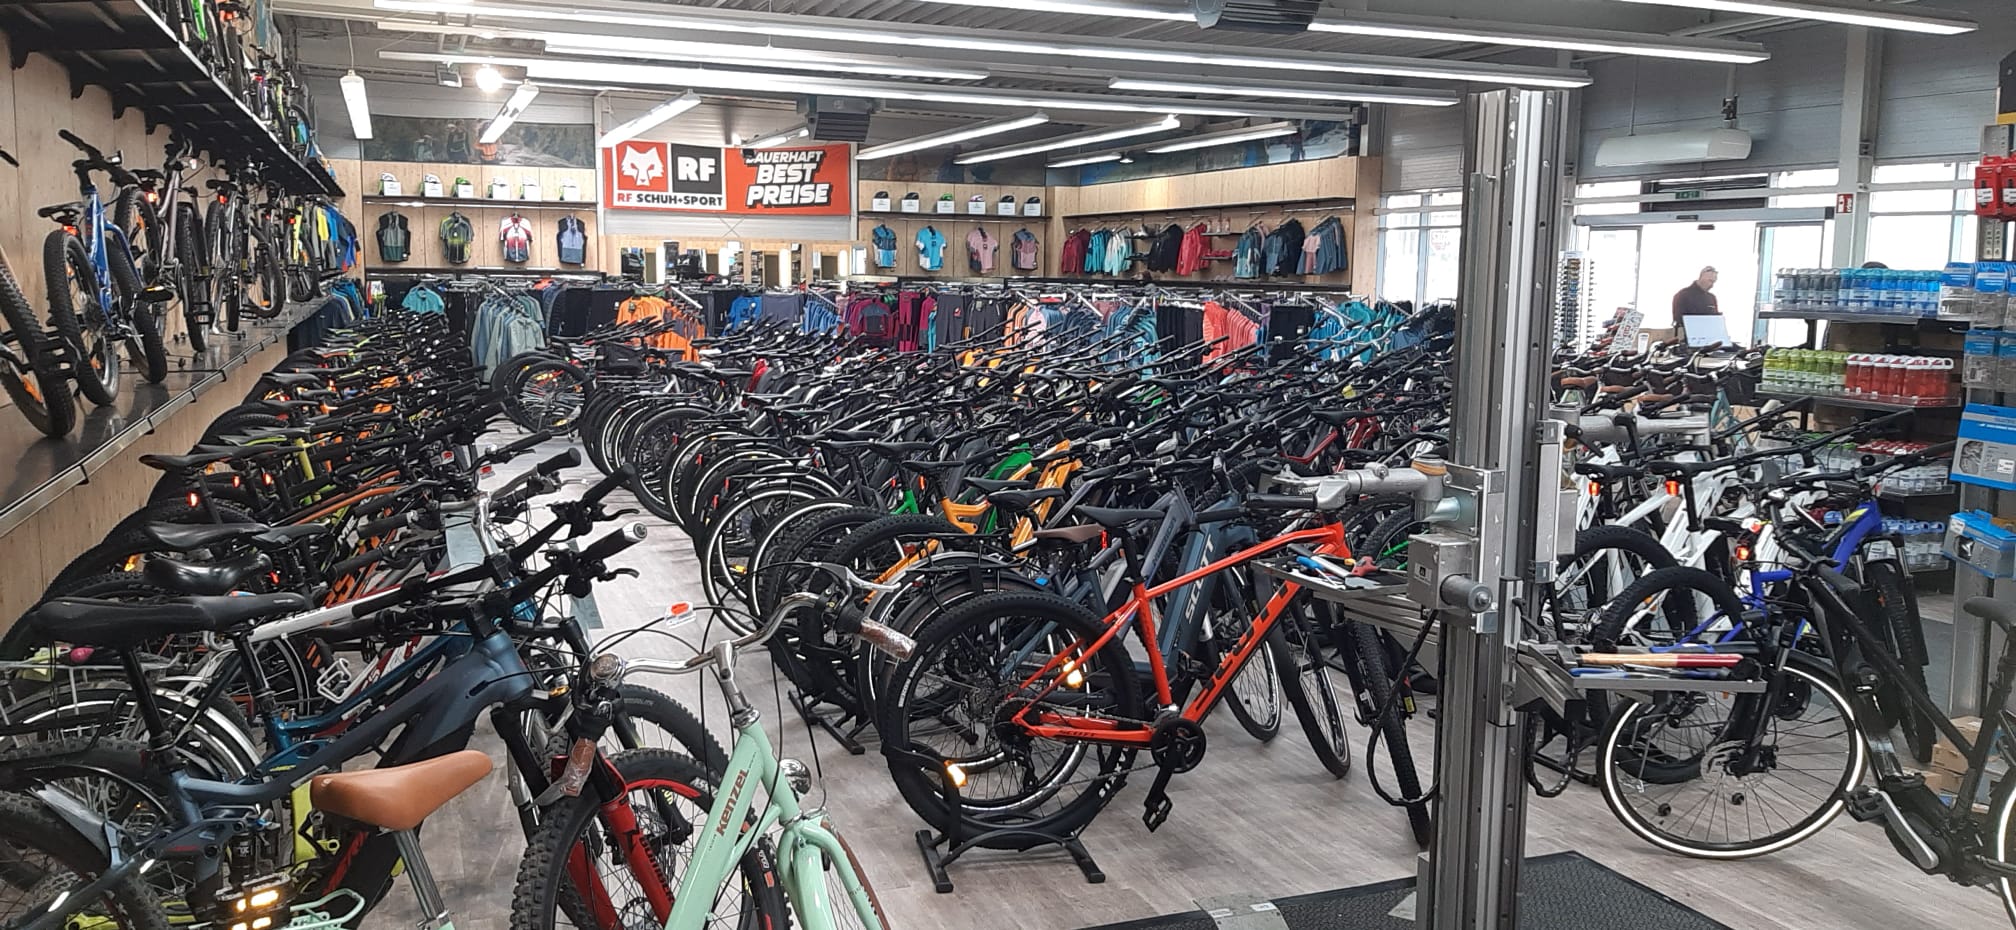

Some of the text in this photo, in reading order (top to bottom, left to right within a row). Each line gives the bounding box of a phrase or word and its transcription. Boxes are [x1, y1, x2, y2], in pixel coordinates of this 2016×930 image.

[677, 156, 717, 182] RF
[756, 163, 817, 184] BEST
[616, 193, 723, 206] RF SCHUH+SPORT
[746, 183, 830, 206] PREISE
